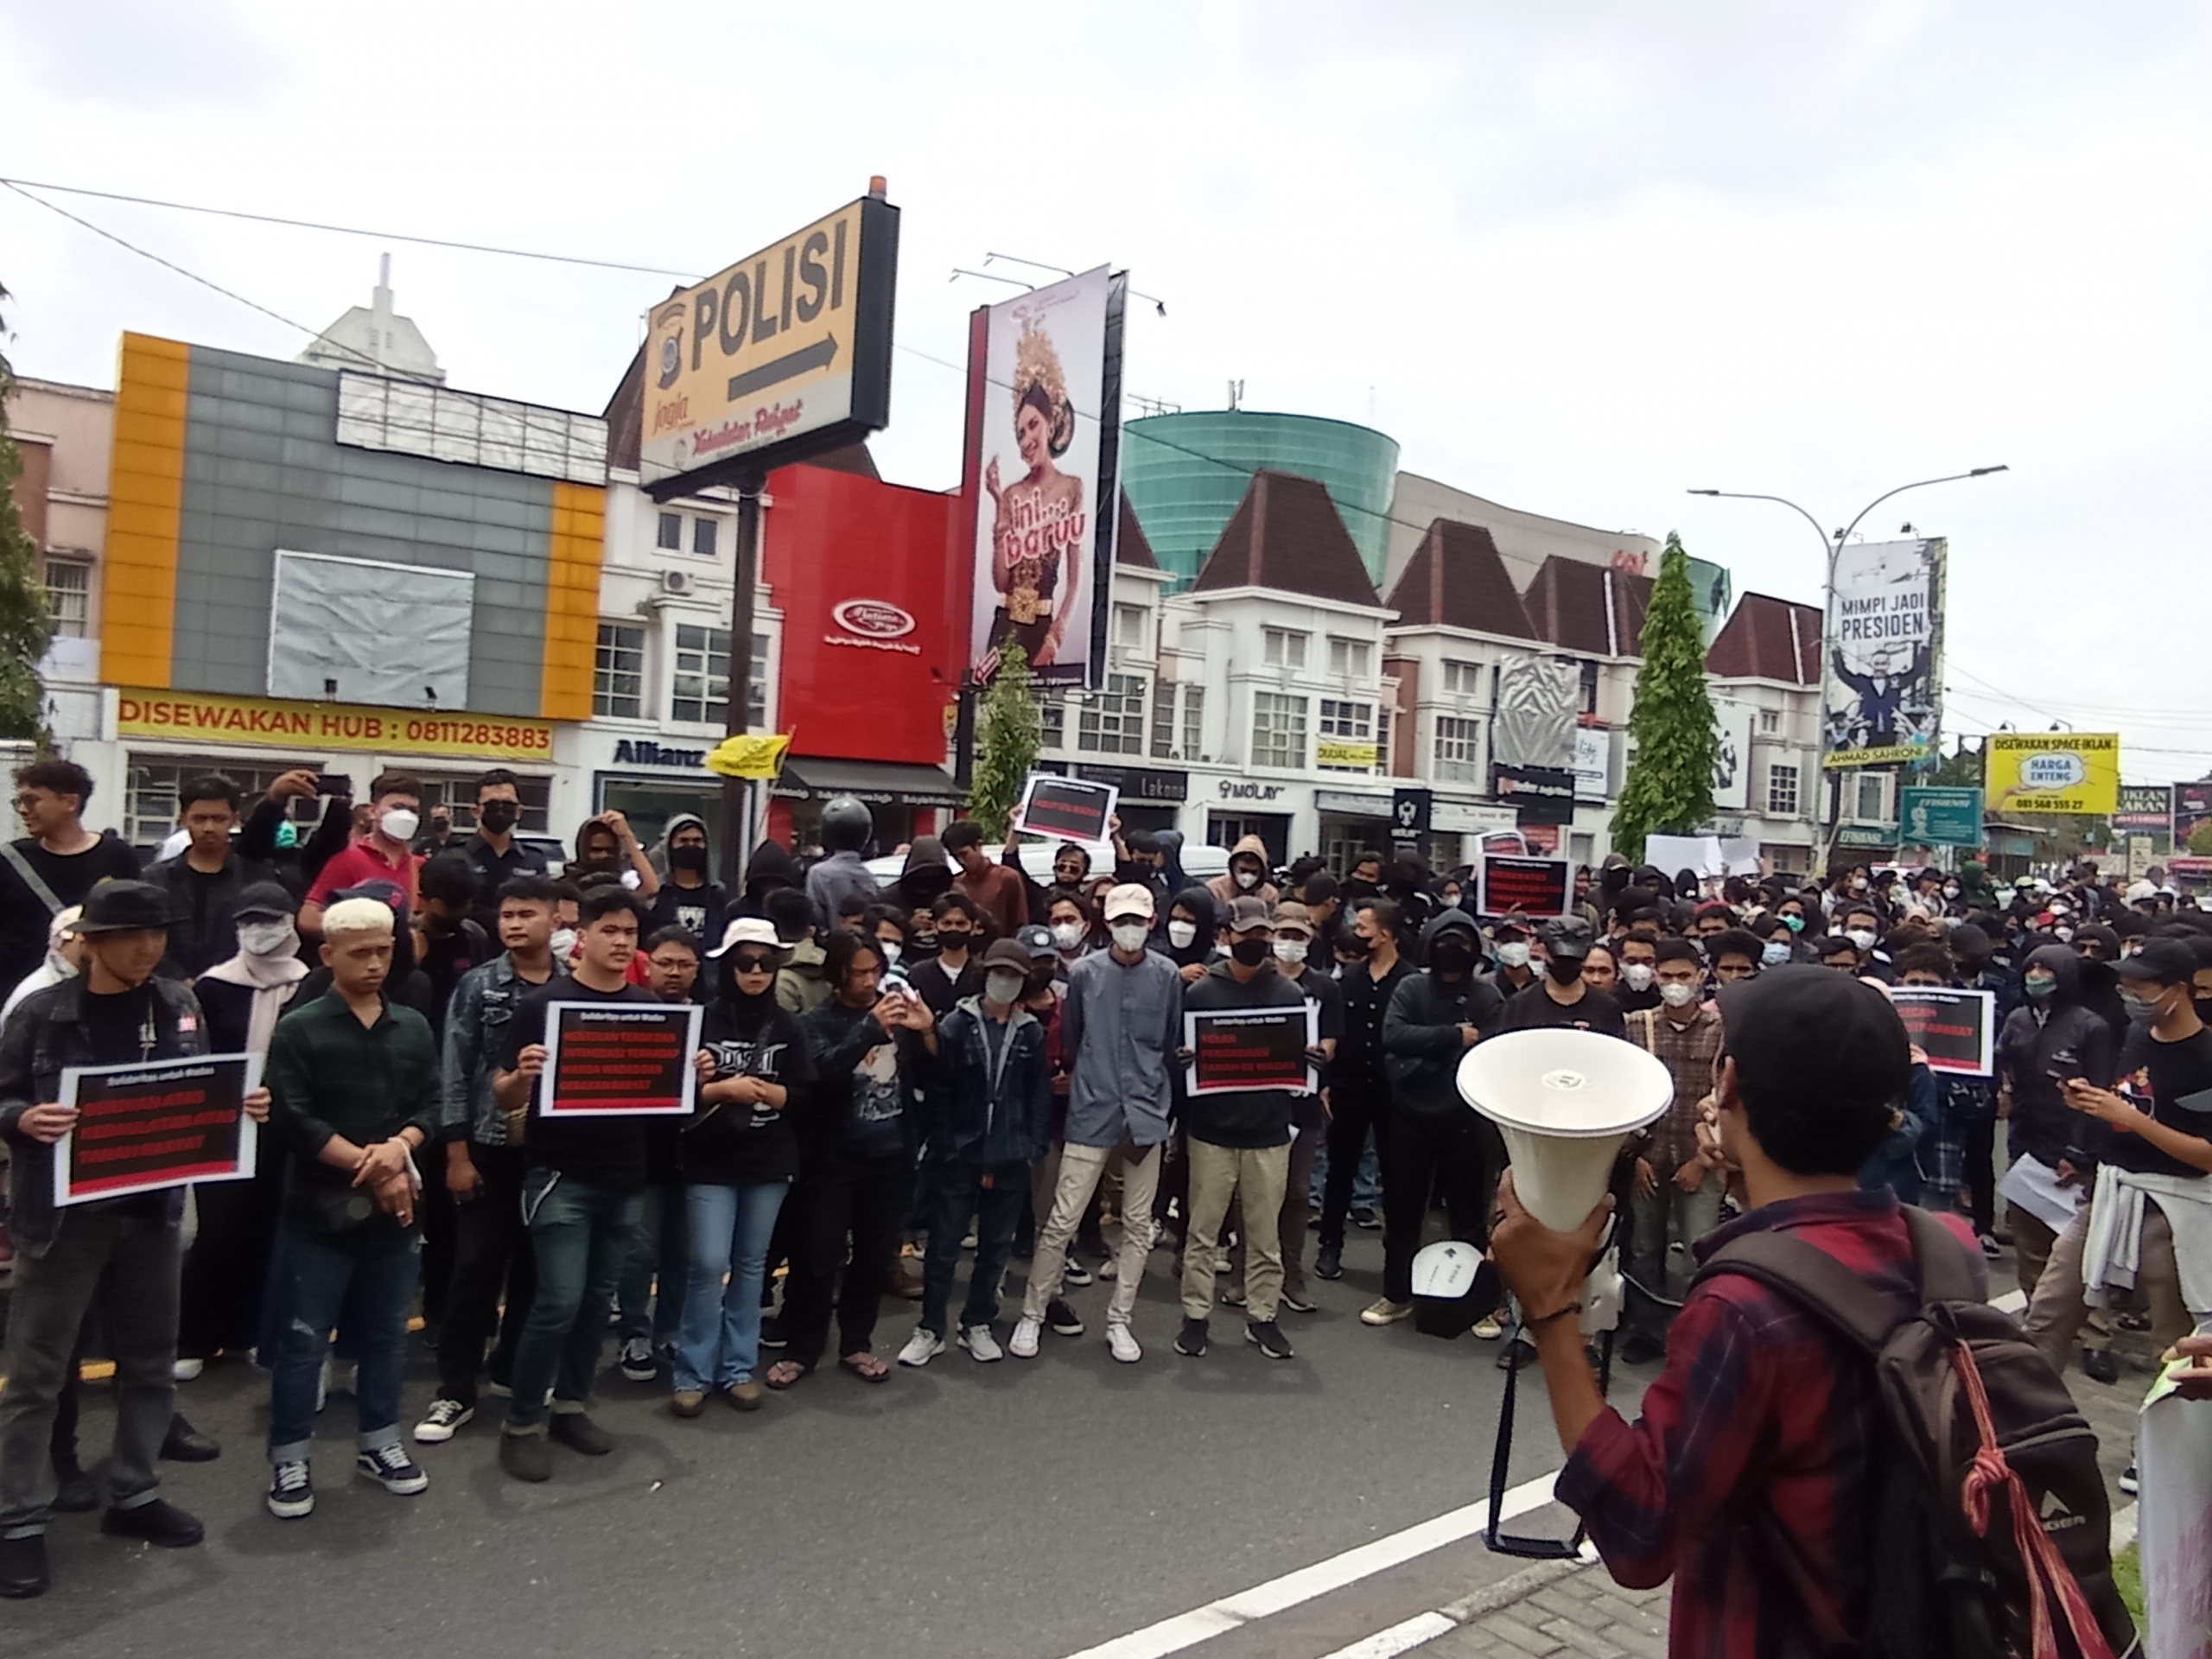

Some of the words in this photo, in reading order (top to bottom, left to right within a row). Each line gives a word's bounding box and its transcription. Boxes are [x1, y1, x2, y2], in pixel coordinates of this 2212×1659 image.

[692, 219, 847, 372] POLISI
[1841, 596, 1885, 616] MIMPI
[1891, 593, 1923, 612] JADI
[1841, 613, 1923, 641] PRESIDEN
[119, 700, 311, 735] DISEWAKAN
[321, 715, 382, 739] HUB
[406, 721, 550, 749] 0811283883
[1995, 738, 2049, 750] DISEWAKAN
[1829, 751, 1870, 764] AHMAD
[1873, 746, 1923, 760] SAHRONI
[2031, 760, 2071, 770] HARGA
[2031, 772, 2071, 781] ENTENG
